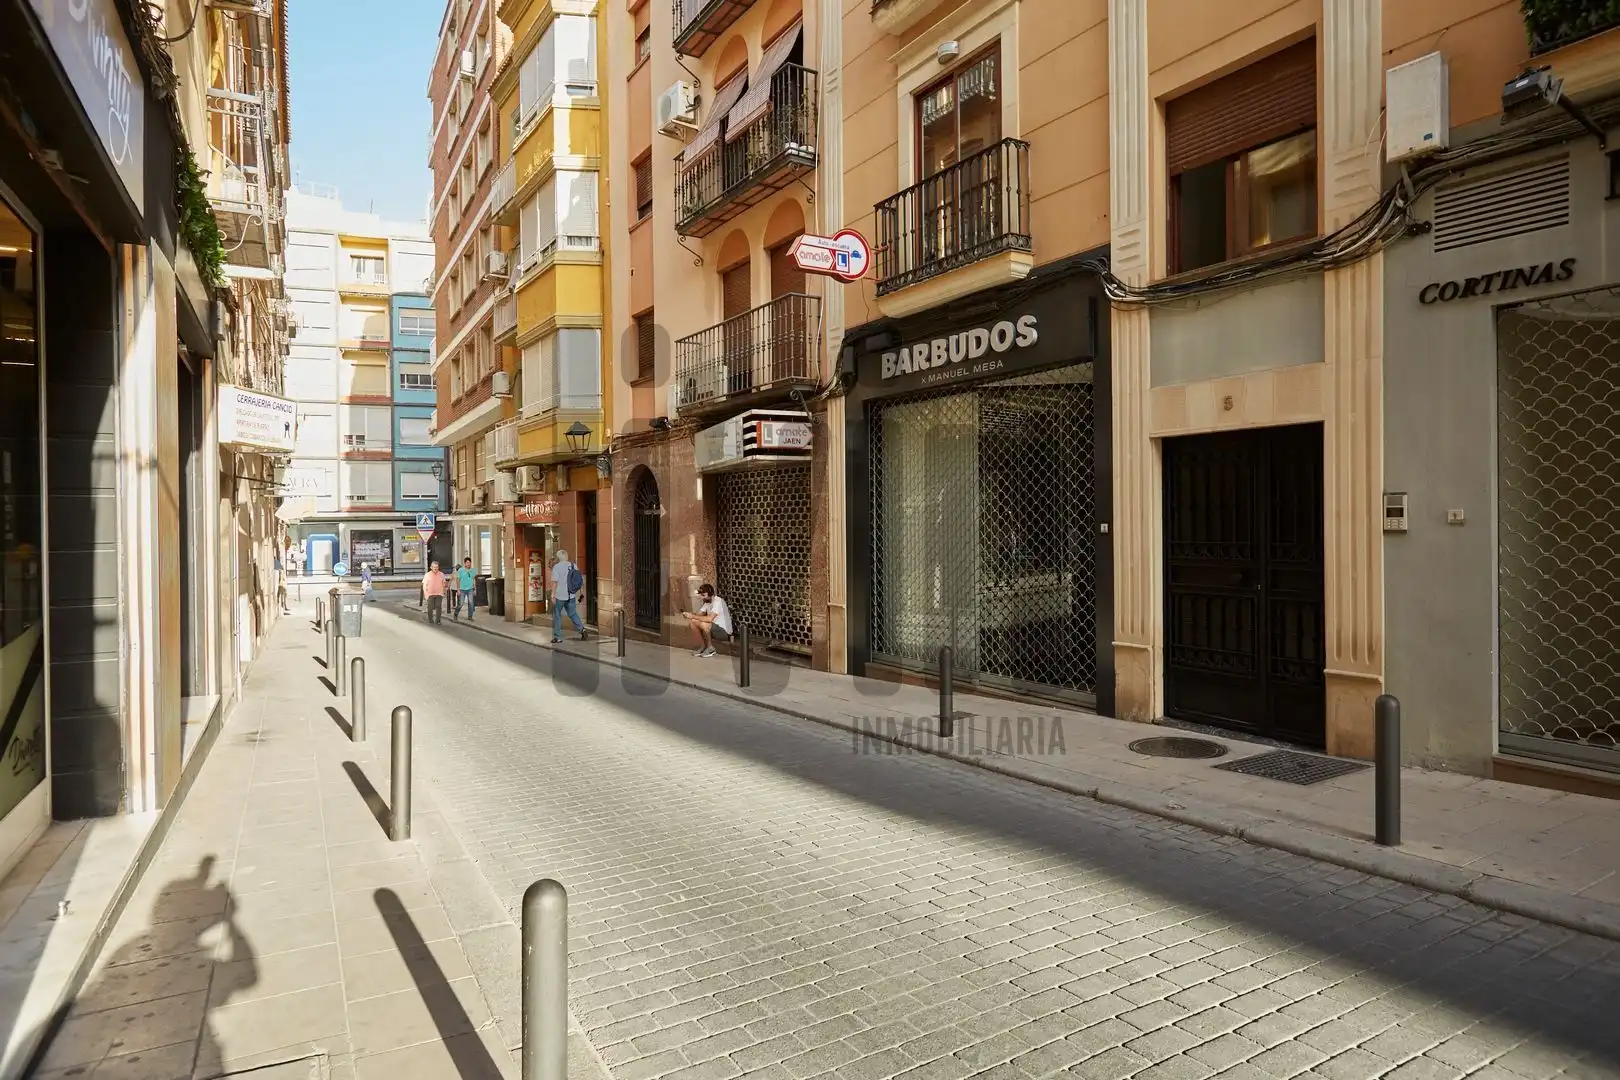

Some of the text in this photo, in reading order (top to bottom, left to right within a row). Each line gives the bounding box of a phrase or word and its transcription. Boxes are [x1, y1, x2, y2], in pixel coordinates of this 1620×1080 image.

[1418, 257, 1577, 305] CORTINAS
[881, 314, 1039, 380] BARBUDOS
[928, 367, 970, 383] MANUEL
[973, 360, 1004, 373] MESA
